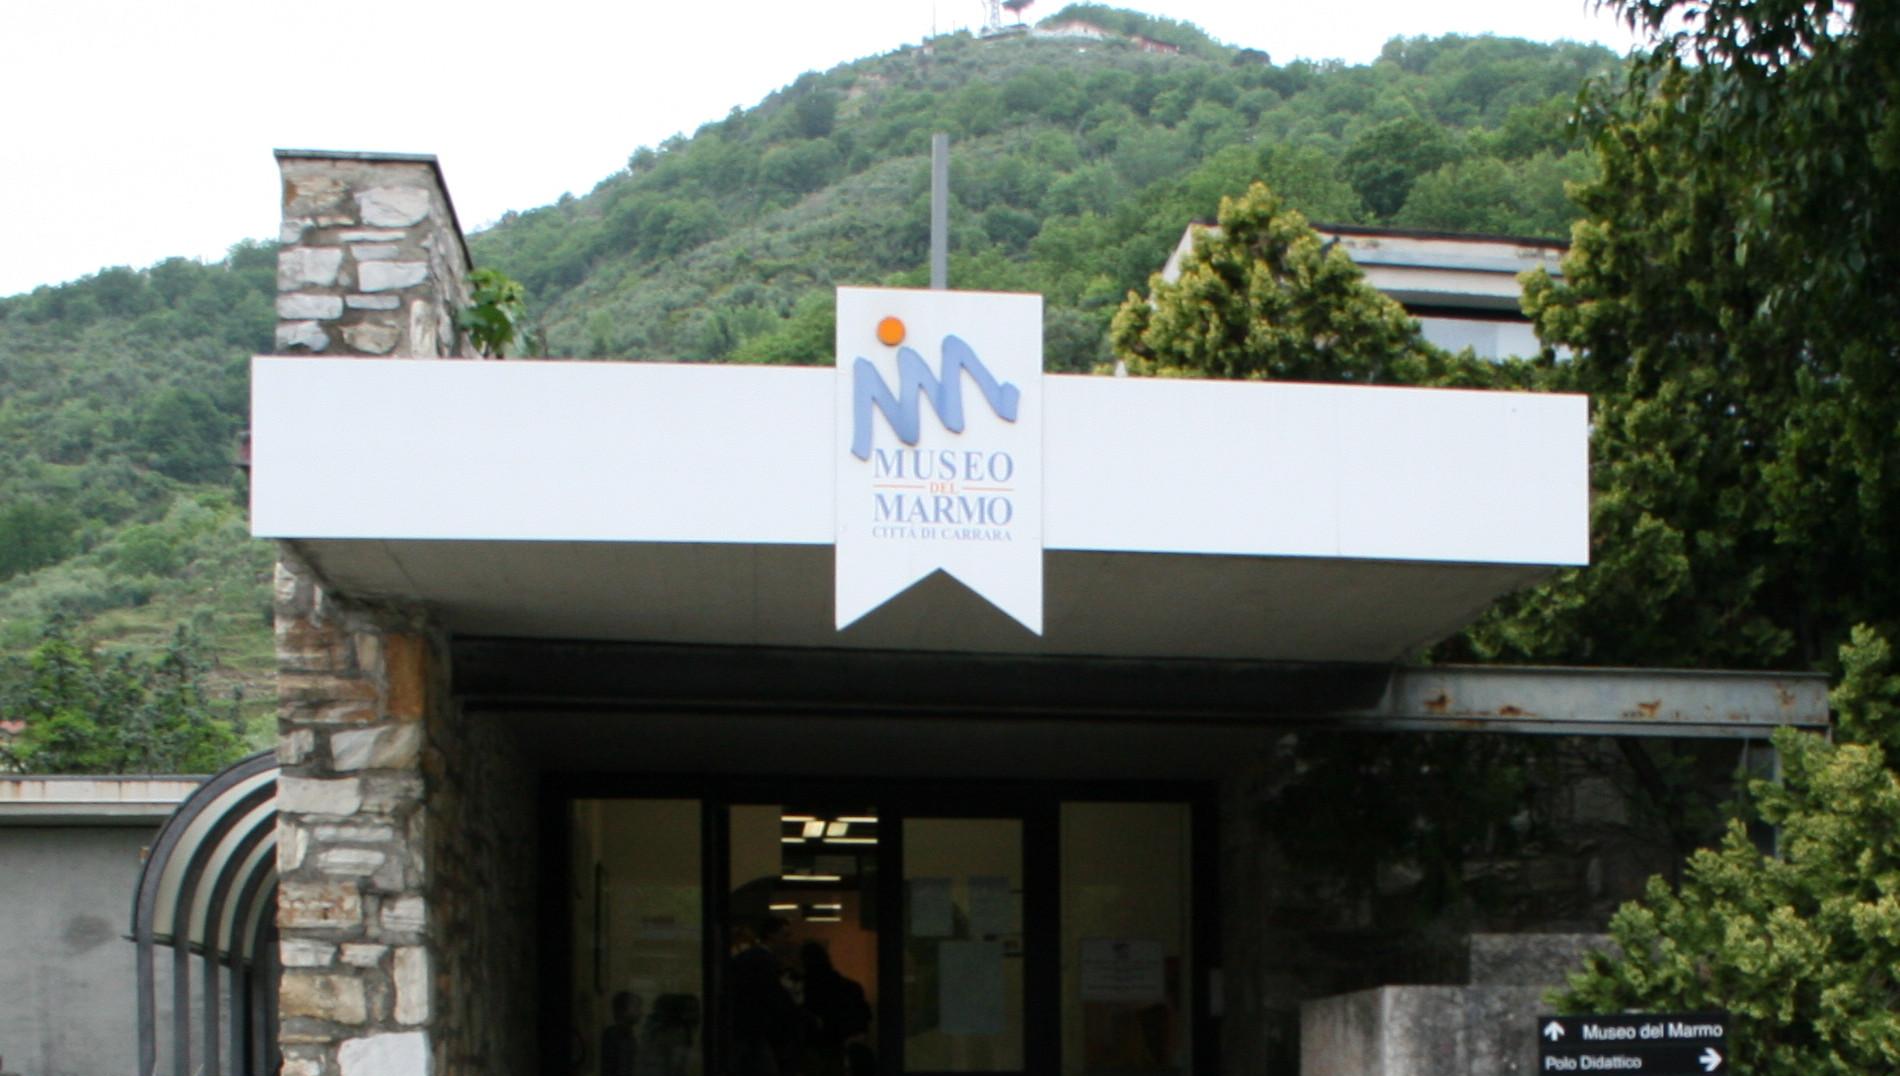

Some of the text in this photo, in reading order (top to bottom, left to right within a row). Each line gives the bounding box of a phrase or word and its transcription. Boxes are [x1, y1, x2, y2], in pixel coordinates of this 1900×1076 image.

[874, 449, 1013, 482] MUSEO
[929, 481, 957, 494] DEL
[873, 493, 1013, 526] MARMO
[921, 527, 936, 539] DI
[941, 528, 1012, 542] CARRARA
[1582, 1022, 1723, 1040] Museo del Marmo
[1544, 1054, 1642, 1070] Polo Didattico
